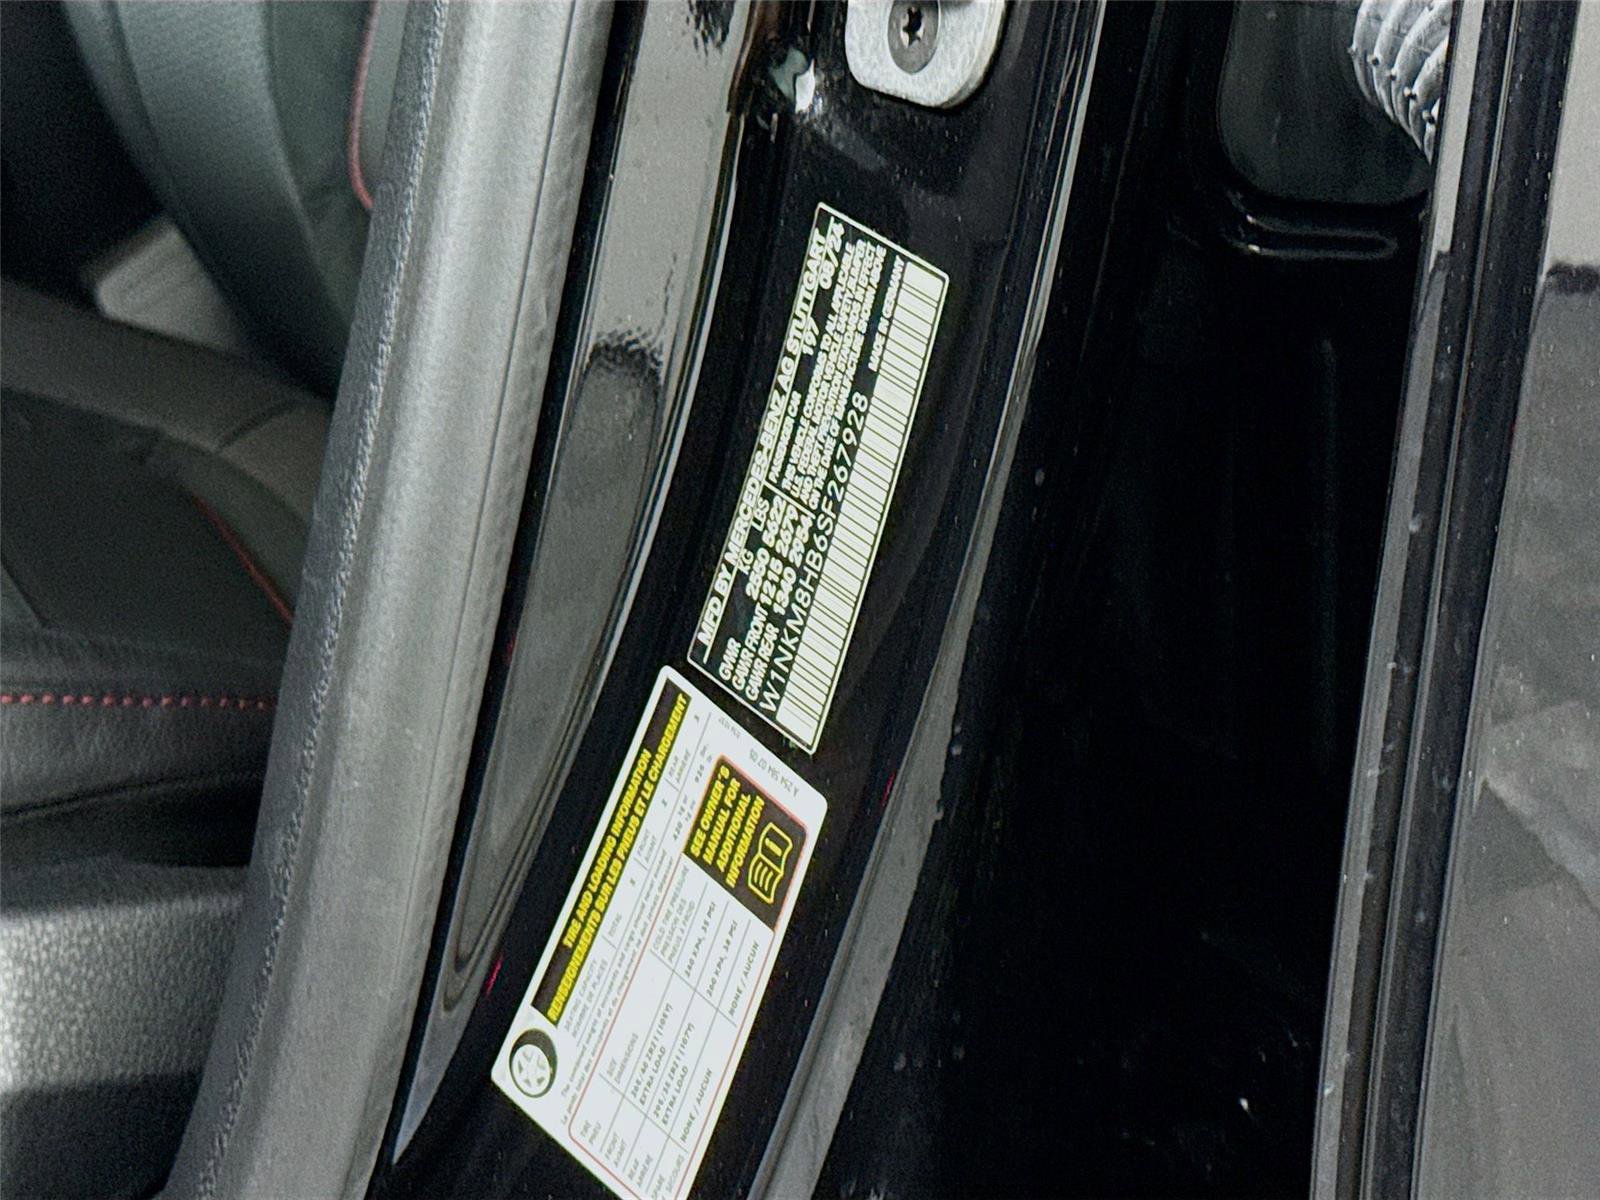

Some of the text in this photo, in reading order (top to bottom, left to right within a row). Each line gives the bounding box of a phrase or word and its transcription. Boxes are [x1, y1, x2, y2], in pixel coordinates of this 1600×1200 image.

[818, 220, 846, 291] 08/24
[800, 315, 821, 358] 197
[867, 331, 885, 372] MADE
[877, 316, 889, 334] IN
[697, 226, 827, 647] MFD BY MERCEDES-BENZ AG STUTTGART
[767, 388, 802, 484] PASSENGER CAR
[738, 495, 770, 575] KG LBS
[744, 494, 787, 601] 2550 5622
[758, 503, 800, 609] 1215 2679
[759, 389, 869, 716] W1NKM8HB6SF267928
[772, 512, 813, 618] 1340 2954
[717, 635, 741, 682] GVWR
[731, 601, 769, 693] GAWR FRONT
[744, 621, 779, 703] GAWR REAR
[546, 693, 688, 1023] RENSEIGNEMENTS SUR LES PNEUS ET LE CHARGEMENT
[562, 747, 652, 950] TIRE AND LOADING INFORMATION
[689, 827, 706, 858] SEE
[702, 775, 741, 865] MANUAL FOR
[715, 789, 752, 872] ADDITIONAL
[724, 794, 766, 889] INFORMATION
